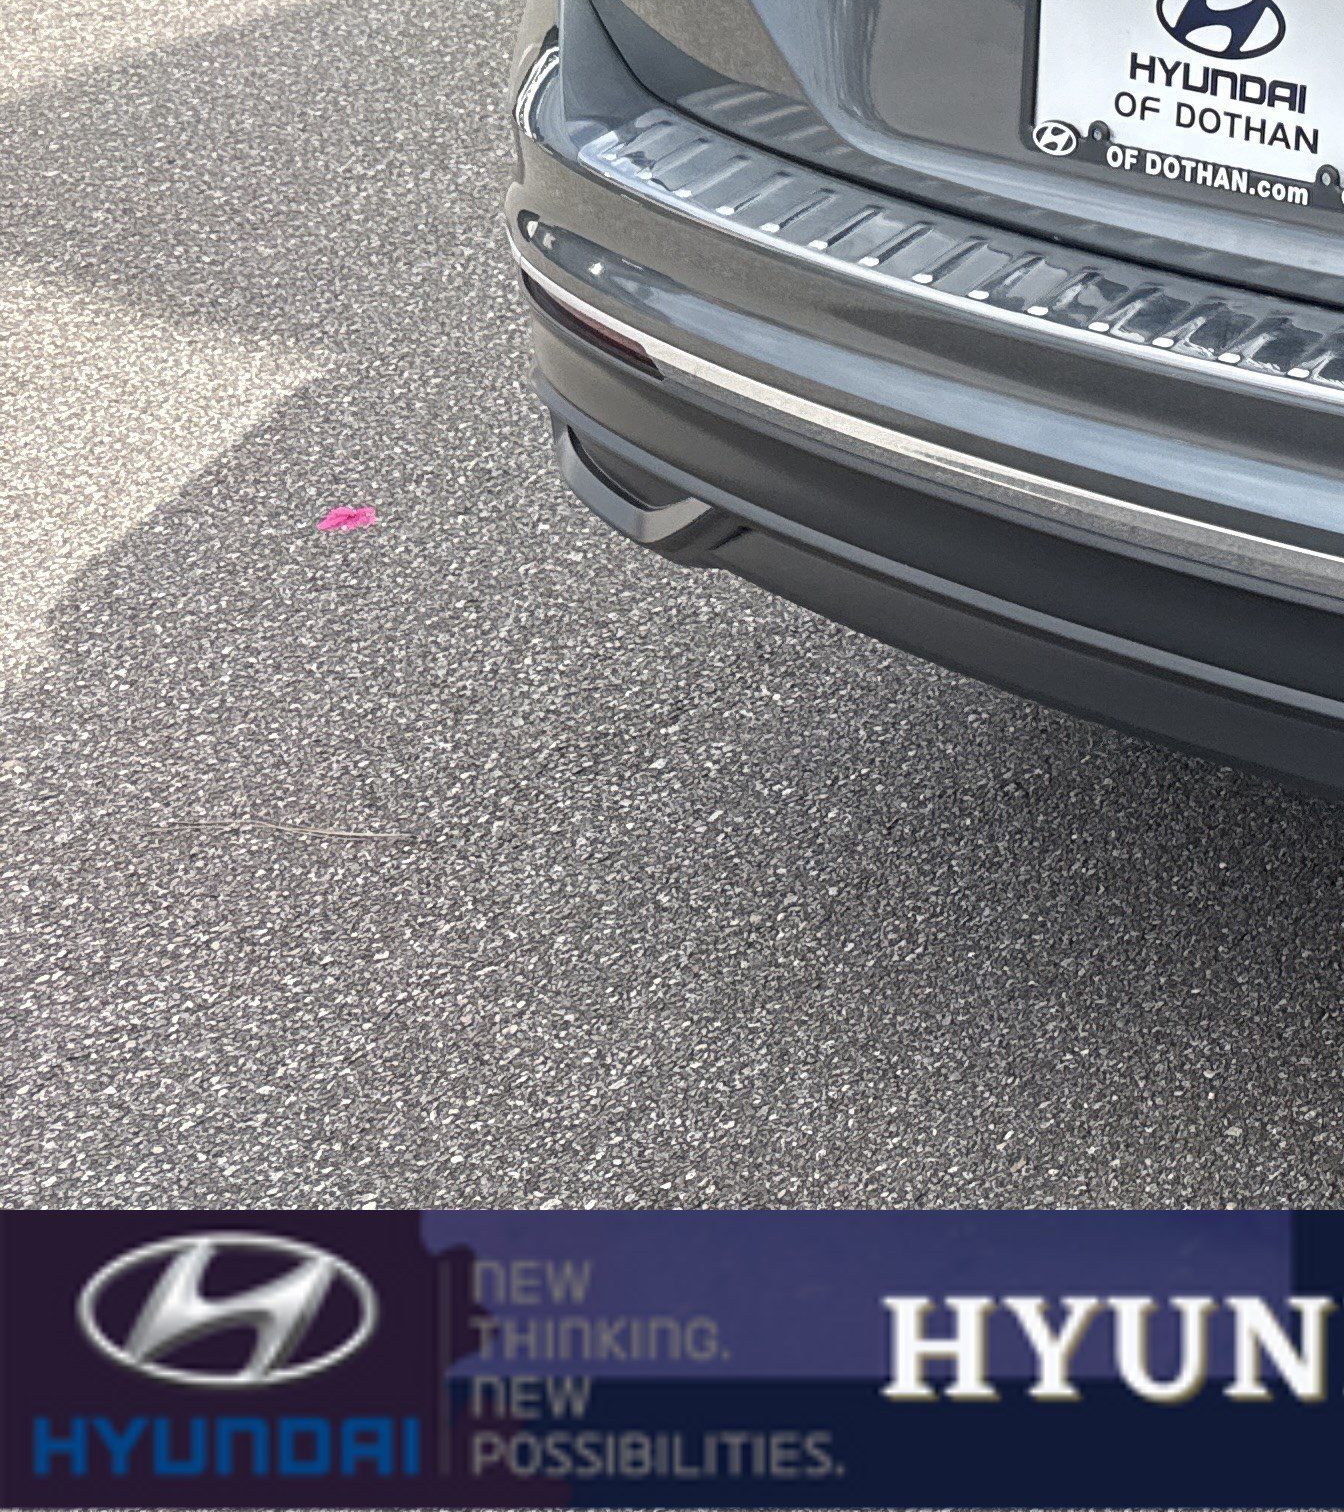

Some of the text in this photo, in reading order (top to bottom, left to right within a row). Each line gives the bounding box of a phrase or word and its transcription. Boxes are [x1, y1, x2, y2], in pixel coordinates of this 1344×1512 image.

[1129, 51, 1307, 114] HYUNDAI
[1114, 91, 1319, 155] OF DOTHAN
[1106, 145, 1309, 206] OF DOTHAN.com
